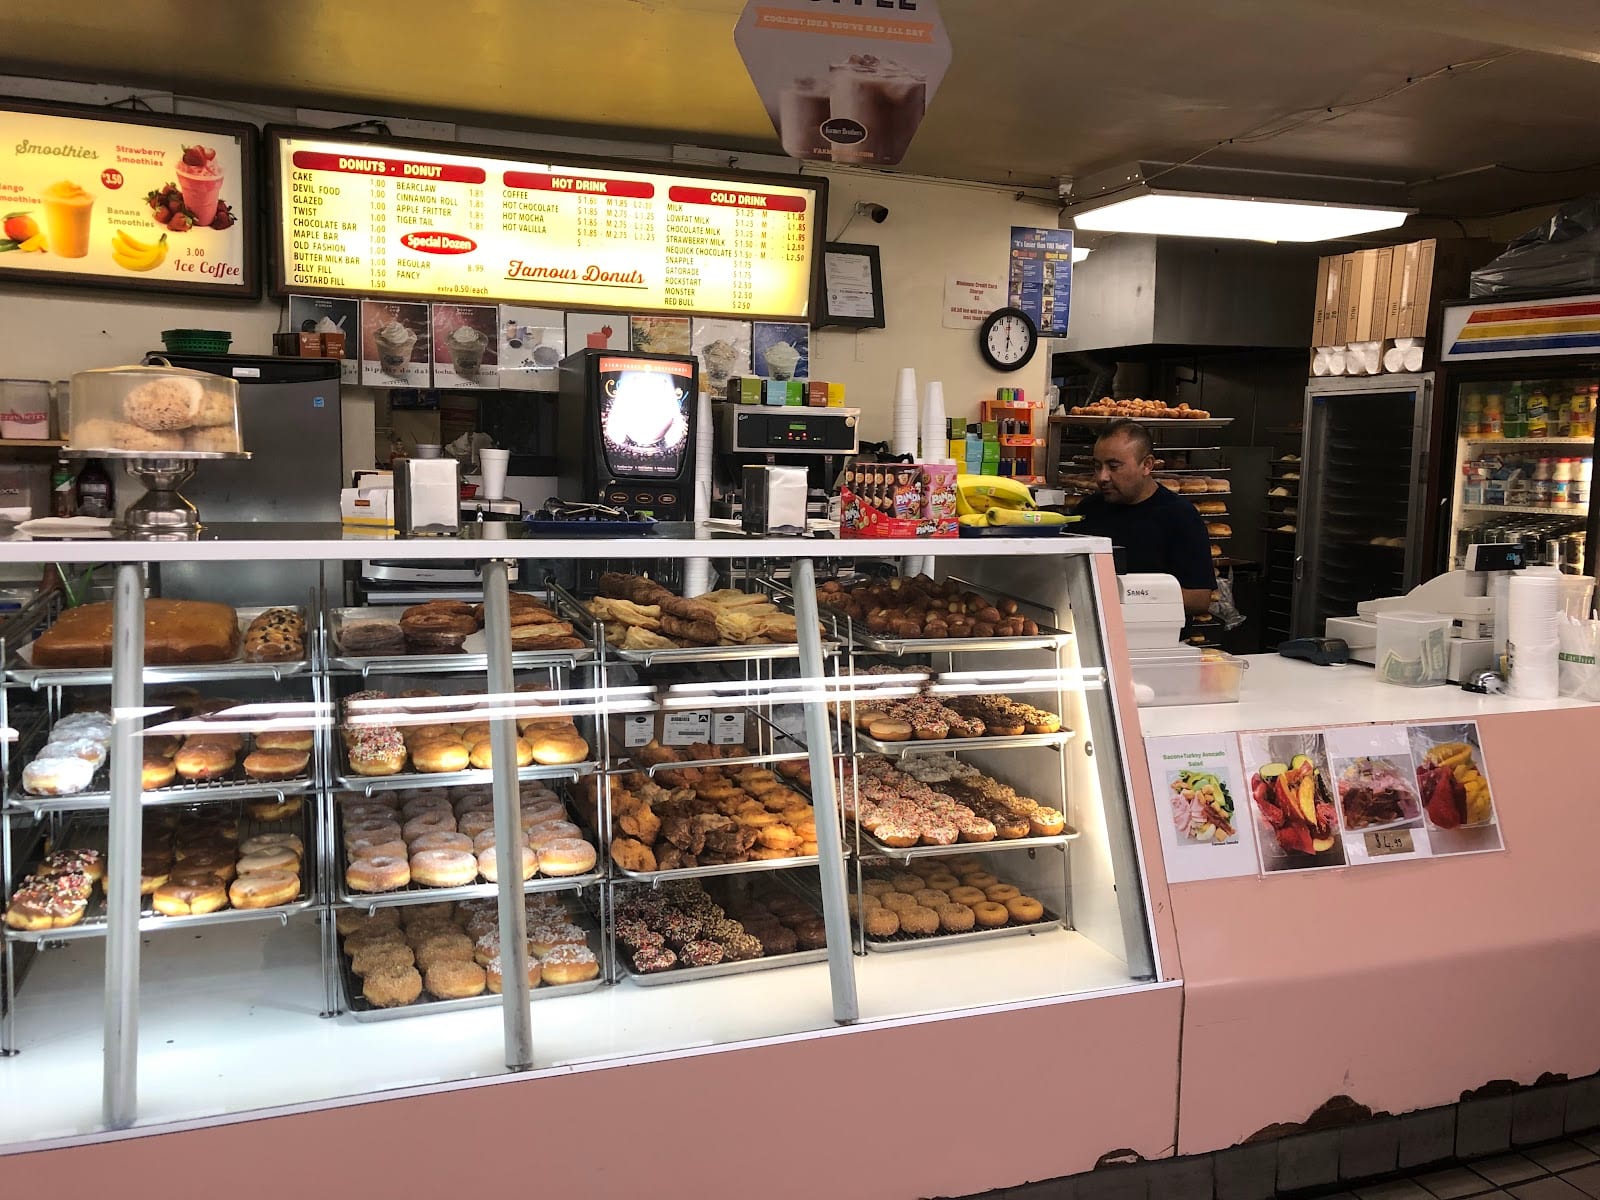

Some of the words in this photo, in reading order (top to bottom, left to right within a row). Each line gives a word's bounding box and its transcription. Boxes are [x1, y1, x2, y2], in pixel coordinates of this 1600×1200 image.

[763, 15, 805, 25] COOLEST
[806, 18, 828, 28] IDEA
[831, 22, 863, 32] YOU'VE
[866, 25, 884, 33] HAD
[886, 27, 904, 35] ALL
[905, 29, 925, 38] DAY
[15, 139, 99, 160] Smoothies
[116, 145, 166, 158] Strawberry
[116, 155, 164, 167] Smoothies
[339, 158, 386, 173] DONUTS
[404, 163, 442, 178] DONUT
[293, 172, 313, 182] CAKE
[293, 184, 315, 194] DEVIL
[319, 185, 340, 196] FOOD
[397, 181, 436, 193] BEARCLAW
[552, 177, 573, 189] HOT
[576, 179, 607, 192] DRINK
[0, 195, 41, 204] moothies
[293, 195, 323, 206] GLAZED
[396, 193, 436, 204] CINNAMON
[440, 196, 458, 207] ROLL
[503, 190, 528, 200] COFFEE
[711, 192, 736, 204] COLD
[739, 194, 767, 207] DRINK
[107, 207, 140, 217] Banana
[293, 206, 317, 216] TWIST
[397, 205, 419, 214] APPLE
[423, 206, 452, 217] FRITTER
[502, 201, 517, 210] HOT
[519, 202, 559, 213] CHOCOLATE
[607, 209, 612, 217] M
[667, 204, 683, 212] MILK
[107, 217, 155, 228] Smoothies
[397, 216, 417, 225] TIGER
[419, 217, 433, 226] TAIL
[502, 212, 517, 221] HOT
[519, 213, 544, 223] MOCHA
[667, 214, 693, 223] LOWFAT
[694, 216, 709, 225] MILK
[293, 218, 338, 230] CHOCOLATE
[342, 221, 357, 231] BAR
[666, 225, 704, 234] CHOCOLATE
[706, 227, 720, 235] MILK
[293, 230, 319, 240] MAPLE
[323, 231, 339, 241] BAR
[502, 223, 517, 232] HOT
[606, 230, 611, 238] M
[408, 234, 441, 249] Special
[442, 236, 471, 250] Dozen
[666, 235, 708, 245] STRAWBERRY
[710, 238, 725, 246] MILK
[186, 247, 205, 257] 3.00
[293, 241, 309, 250] OLD
[313, 242, 346, 253] FASHION
[666, 246, 694, 255] NEQUICK
[696, 247, 732, 257] CHOCOLATE
[294, 252, 323, 262] BUTTER
[325, 254, 343, 264] MILK
[345, 256, 360, 265] BAR
[666, 257, 694, 265] SNAPPLE
[174, 259, 195, 273] Ice
[200, 262, 240, 278] Coffee
[397, 259, 431, 270] REGULAR
[294, 263, 314, 273] JELLY
[318, 265, 332, 274] FILL
[370, 269, 386, 278] 1.50
[397, 270, 420, 280] FANCY
[508, 259, 578, 280] Famous
[582, 265, 644, 284] Donuts
[666, 267, 699, 275] GATORADE
[294, 275, 329, 285] CUSTARD
[330, 276, 345, 286] FILL
[370, 280, 386, 289] 1.50
[665, 277, 701, 286] ROCKSTART
[438, 285, 453, 293] extra
[665, 287, 695, 296] MONSTER
[665, 298, 677, 306] RED
[678, 298, 694, 307] BULL
[896, 491, 921, 505] PANDA
[932, 491, 957, 505] PANDA
